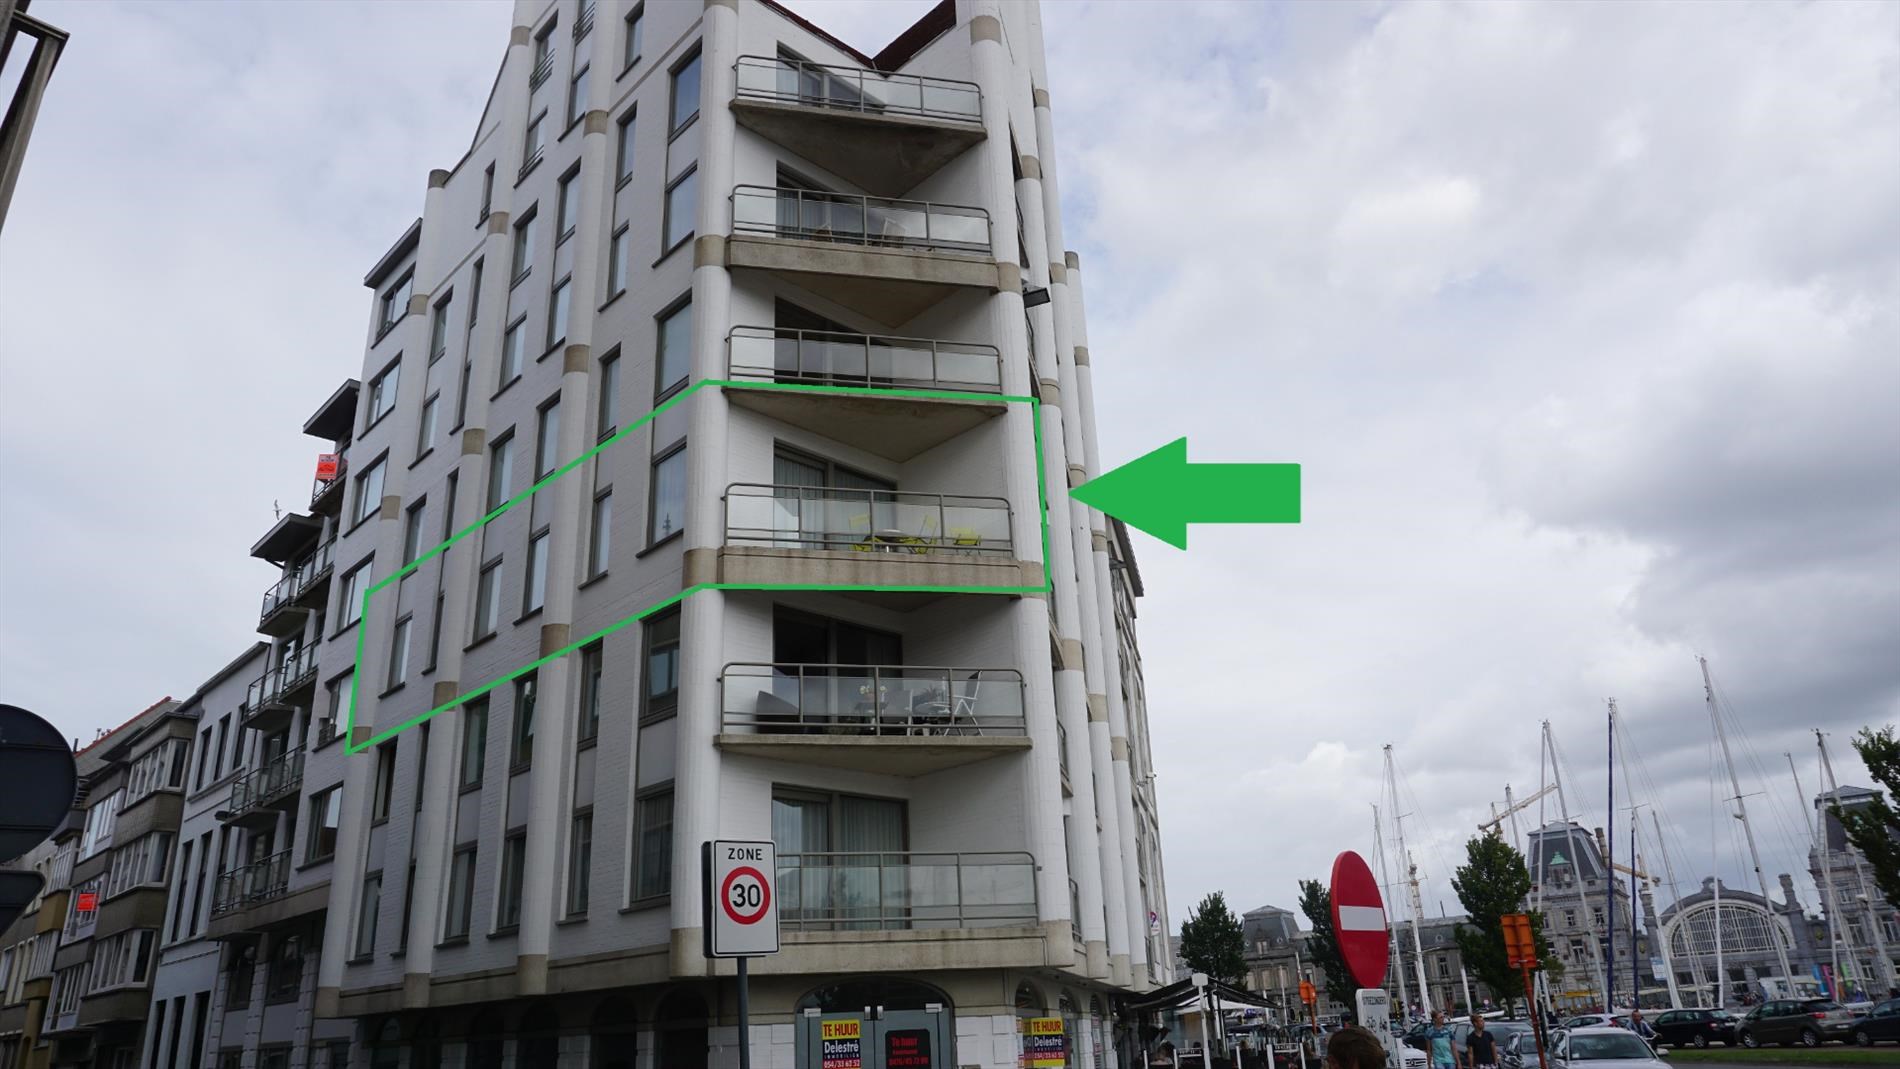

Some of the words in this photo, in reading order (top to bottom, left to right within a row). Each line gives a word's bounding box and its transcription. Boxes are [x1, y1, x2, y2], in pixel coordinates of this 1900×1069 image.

[728, 848, 763, 861] ZONE
[732, 884, 761, 908] 30
[823, 1024, 832, 1037] TE
[834, 1023, 859, 1036] HUUR
[1033, 1022, 1040, 1032] TE
[1042, 1021, 1062, 1032] HUUR
[824, 1040, 859, 1053] Delestré
[1034, 1035, 1062, 1047] Delestré
